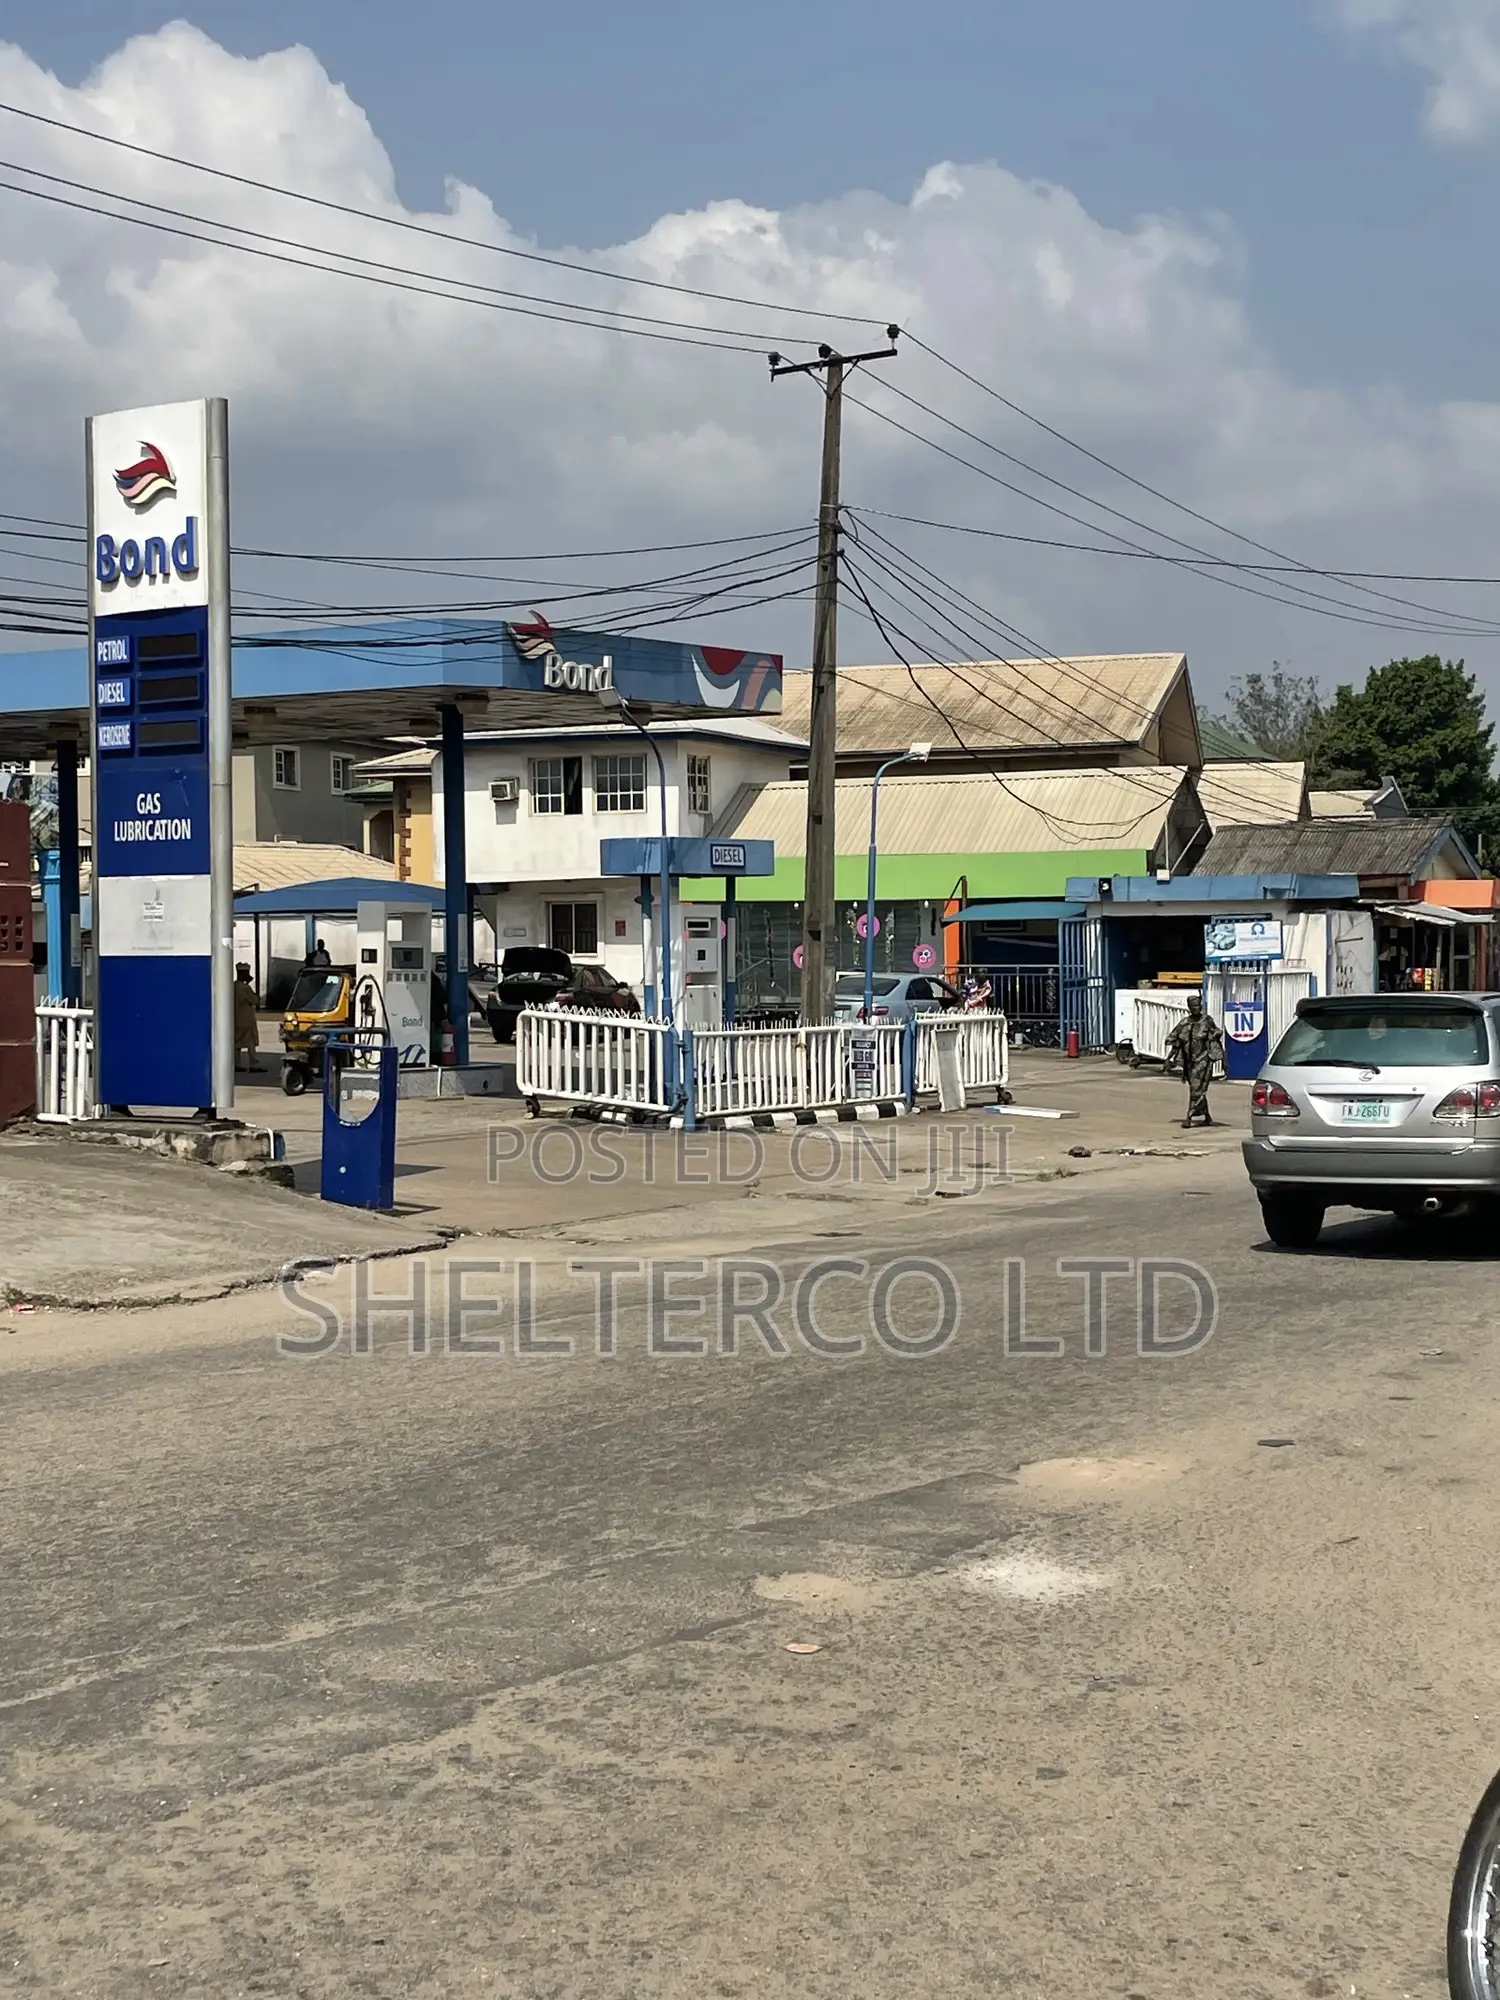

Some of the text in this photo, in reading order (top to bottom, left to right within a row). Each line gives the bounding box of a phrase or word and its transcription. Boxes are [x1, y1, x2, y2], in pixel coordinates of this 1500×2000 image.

[96, 516, 199, 583] Bond
[97, 639, 128, 662] PETROL
[544, 653, 613, 692] Bond
[98, 682, 126, 704] DIESEL
[99, 724, 130, 747] KEROSENE
[136, 792, 161, 815] GAS
[114, 818, 192, 842] LUBRICATION
[714, 848, 743, 863] DIESEL
[402, 1016, 423, 1027] Bond
[1234, 1012, 1254, 1032] IN
